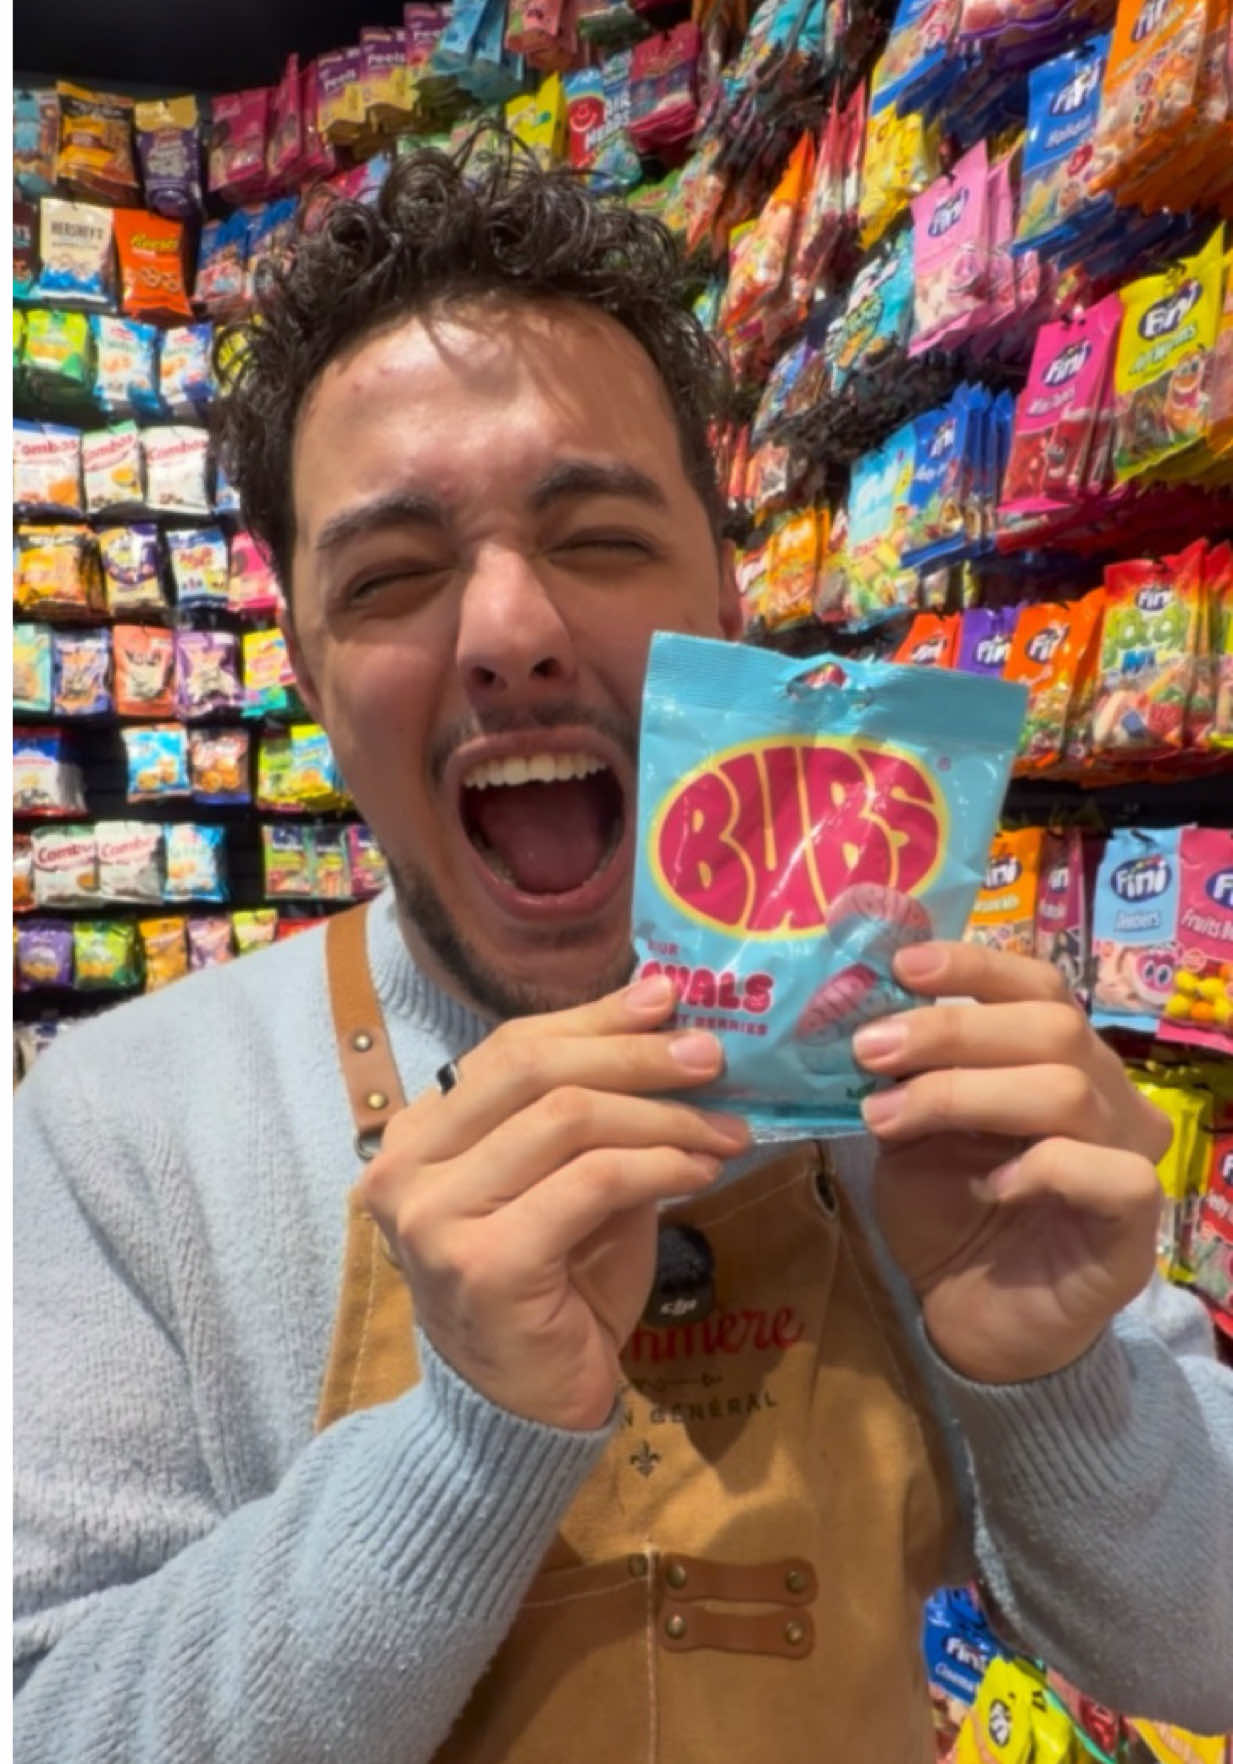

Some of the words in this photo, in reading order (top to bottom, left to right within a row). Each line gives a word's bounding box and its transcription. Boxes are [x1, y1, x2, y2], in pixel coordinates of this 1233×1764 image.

[658, 746, 940, 932] BUBS
[983, 856, 1018, 889] ini
[1114, 856, 1167, 898] Fini
[694, 1014, 768, 1036] BERRIES
